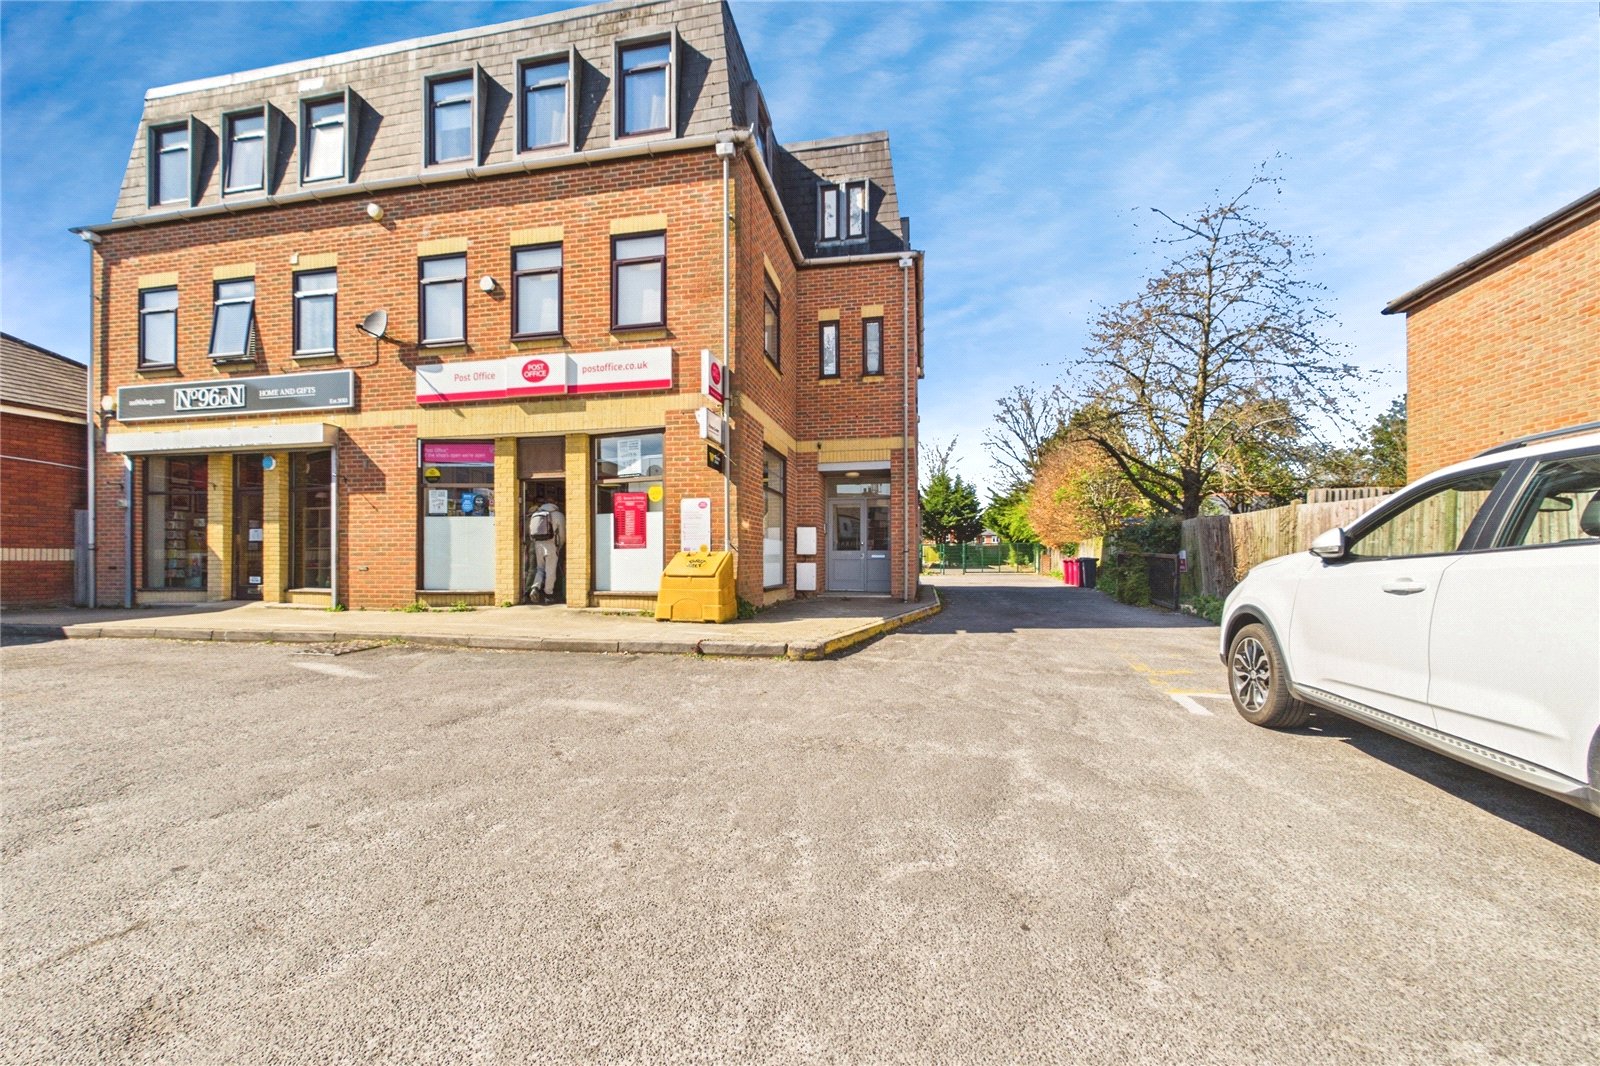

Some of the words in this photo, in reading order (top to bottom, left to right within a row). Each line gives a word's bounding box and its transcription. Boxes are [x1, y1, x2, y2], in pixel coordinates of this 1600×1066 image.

[527, 363, 545, 371] POST
[582, 360, 648, 375] postoffice.co.uk
[454, 373, 471, 382] Post
[473, 372, 496, 381] Office
[523, 370, 547, 378] OFFICE
[259, 388, 279, 397] HOME
[280, 387, 295, 395] AND
[296, 386, 316, 394] GIFTS
